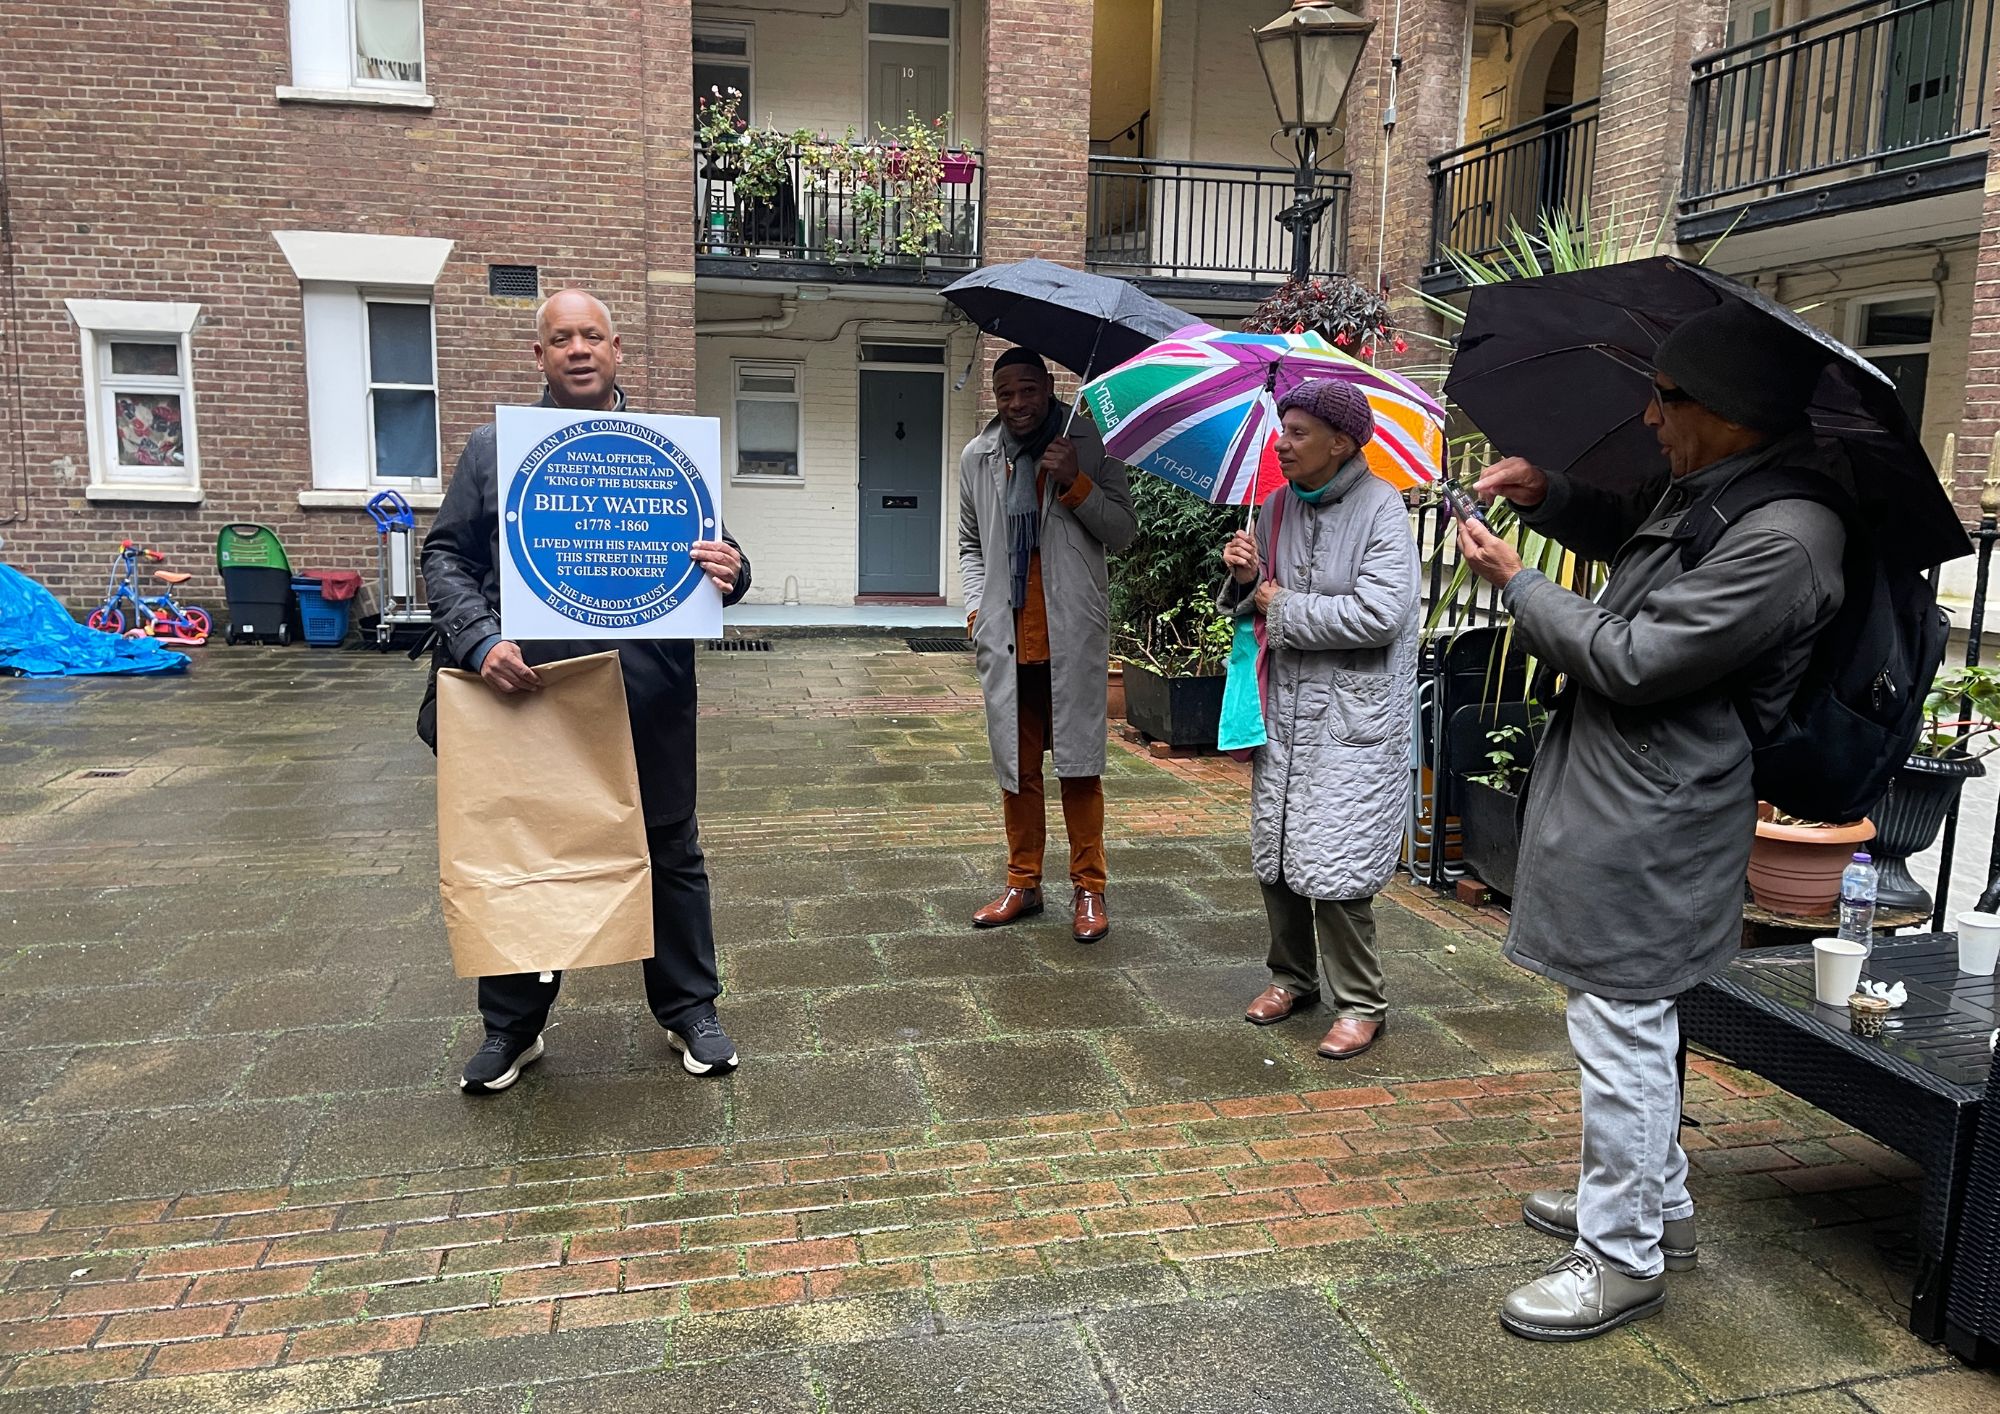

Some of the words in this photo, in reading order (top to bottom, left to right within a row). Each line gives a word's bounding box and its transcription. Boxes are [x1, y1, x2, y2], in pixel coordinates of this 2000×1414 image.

[903, 67, 914, 78] 10
[520, 435, 560, 476] NUBIAN
[561, 424, 587, 440] JAK
[590, 420, 668, 448] COMMUNITY
[669, 446, 701, 481] TRUST
[567, 452, 604, 462] NAVAL
[606, 453, 655, 466] OFFICER,
[547, 463, 590, 474] STREET
[592, 465, 648, 476] MUSICIAN
[650, 468, 674, 477] AND
[544, 475, 578, 486] "KING
[580, 477, 595, 486] OF
[597, 478, 620, 487] THE
[534, 494, 599, 512] BILLY
[602, 496, 688, 515] WATERS
[575, 518, 611, 530] c1778
[534, 538, 570, 549] LIVED
[573, 539, 603, 549] WITH
[606, 540, 625, 550] HIS
[627, 541, 670, 551] FAMILY
[671, 542, 688, 552] ON
[556, 552, 582, 562] THIS
[585, 553, 628, 563] STREET
[631, 554, 643, 564] IN
[645, 554, 668, 564] THE
[557, 566, 572, 575] ST
[574, 566, 608, 576] GILES
[610, 567, 666, 577] ROOKERY
[558, 581, 579, 600] THE
[580, 593, 633, 610] PEABODY
[633, 583, 667, 605] TRUST
[546, 594, 586, 621] BLACK
[587, 613, 639, 626] HISTORY
[640, 596, 679, 621] WALKS
